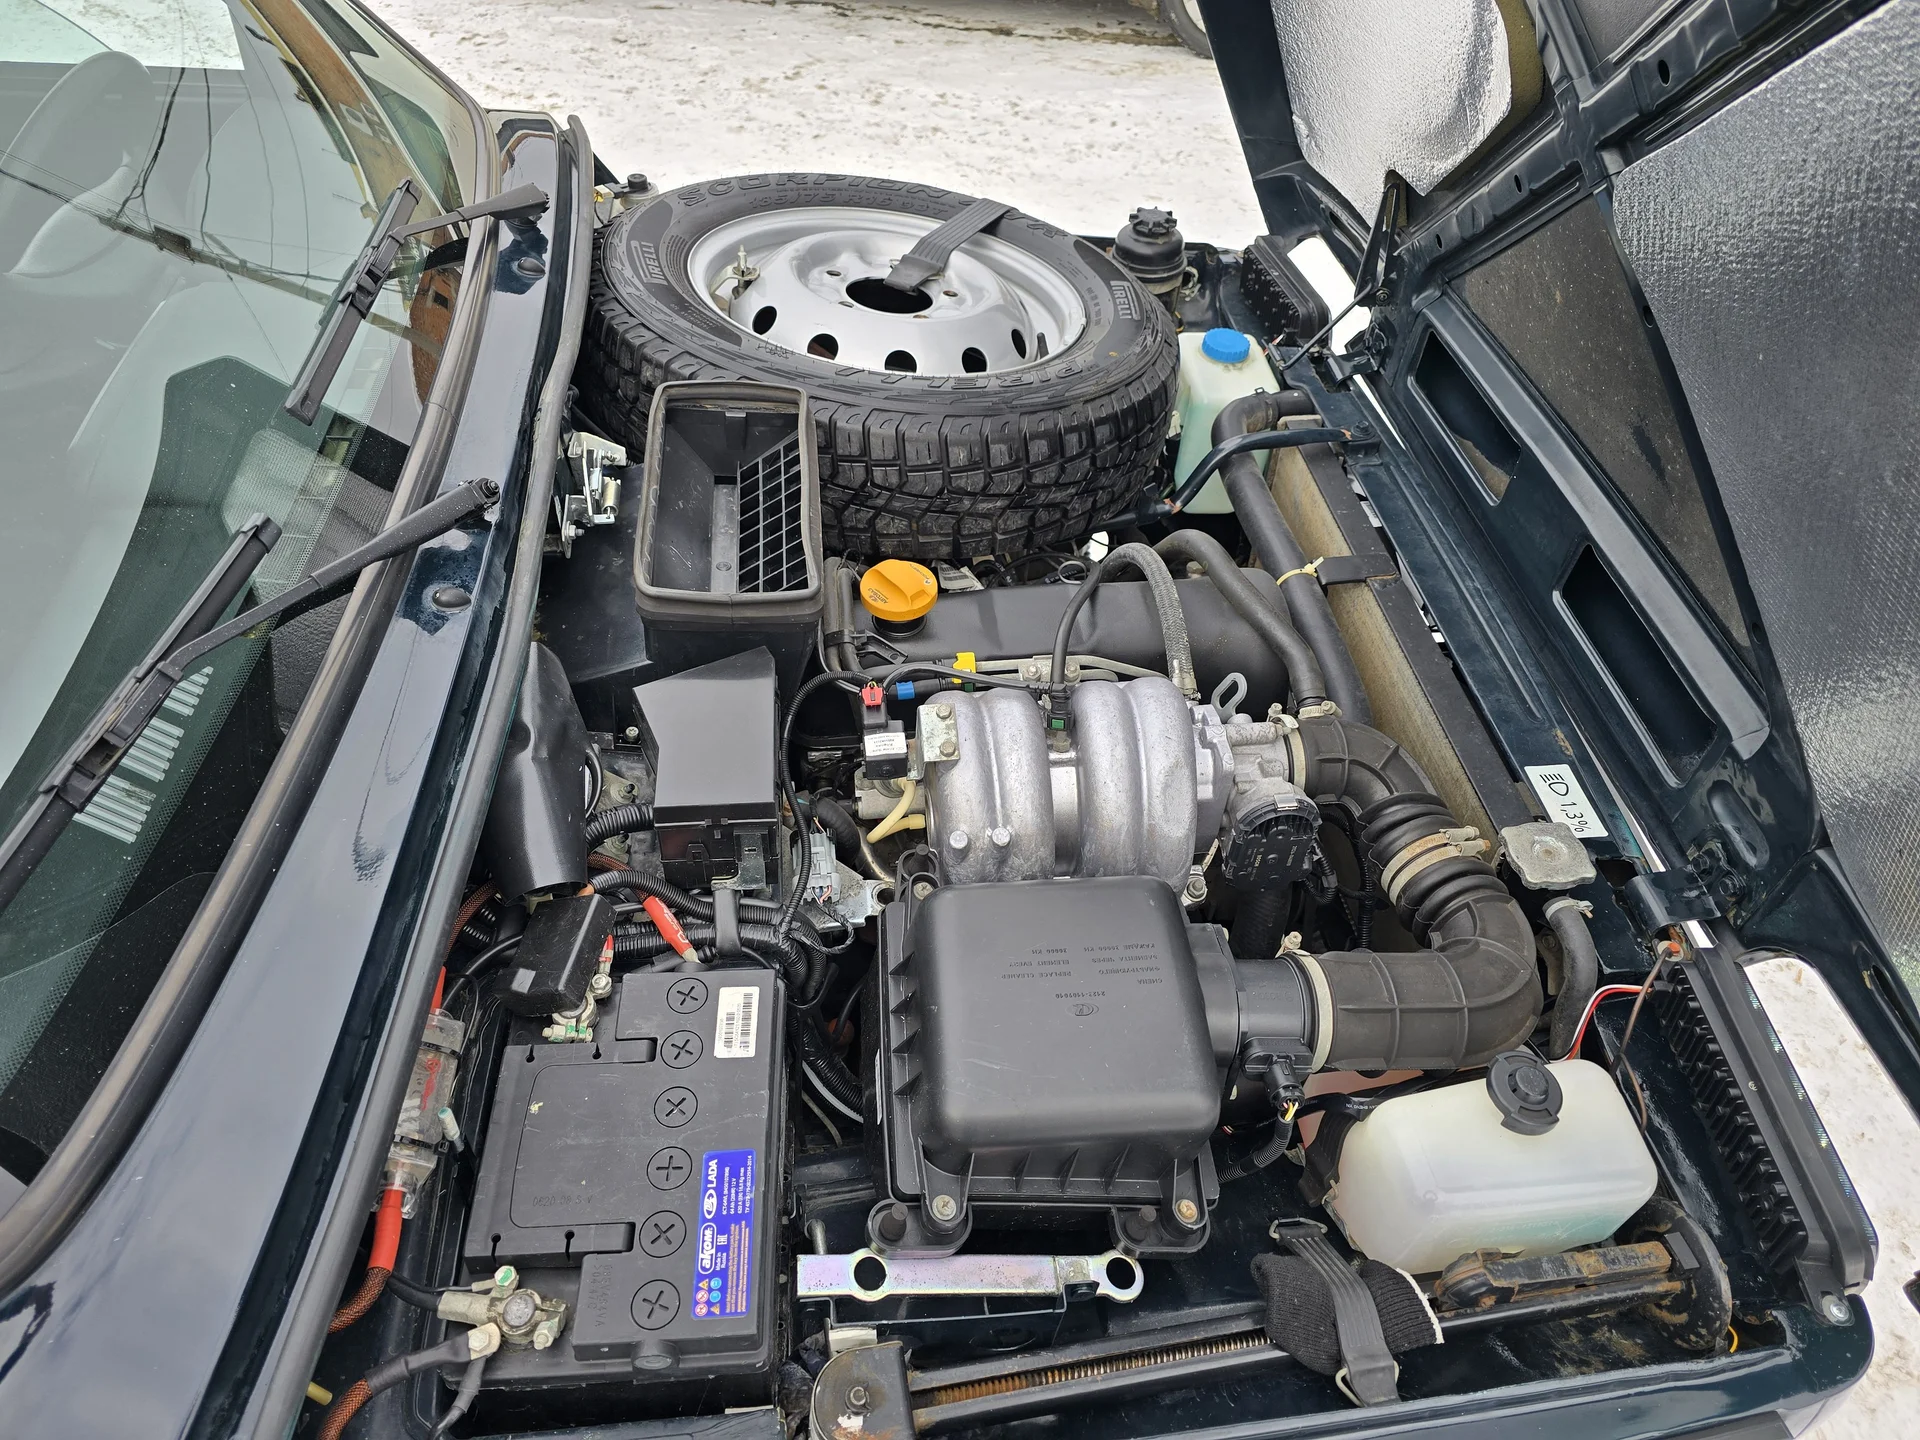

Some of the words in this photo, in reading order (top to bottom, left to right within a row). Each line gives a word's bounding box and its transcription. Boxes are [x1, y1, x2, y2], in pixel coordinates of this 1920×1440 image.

[677, 172, 950, 207] SCORPION
[630, 240, 668, 286] PIRELLI
[1110, 280, 1141, 320] PIRELLI
[835, 360, 1086, 390] PIRELLI
[1559, 801, 1592, 833] 1,3%
[1039, 970, 1072, 978] REPLACE
[707, 1158, 717, 1187] LADA
